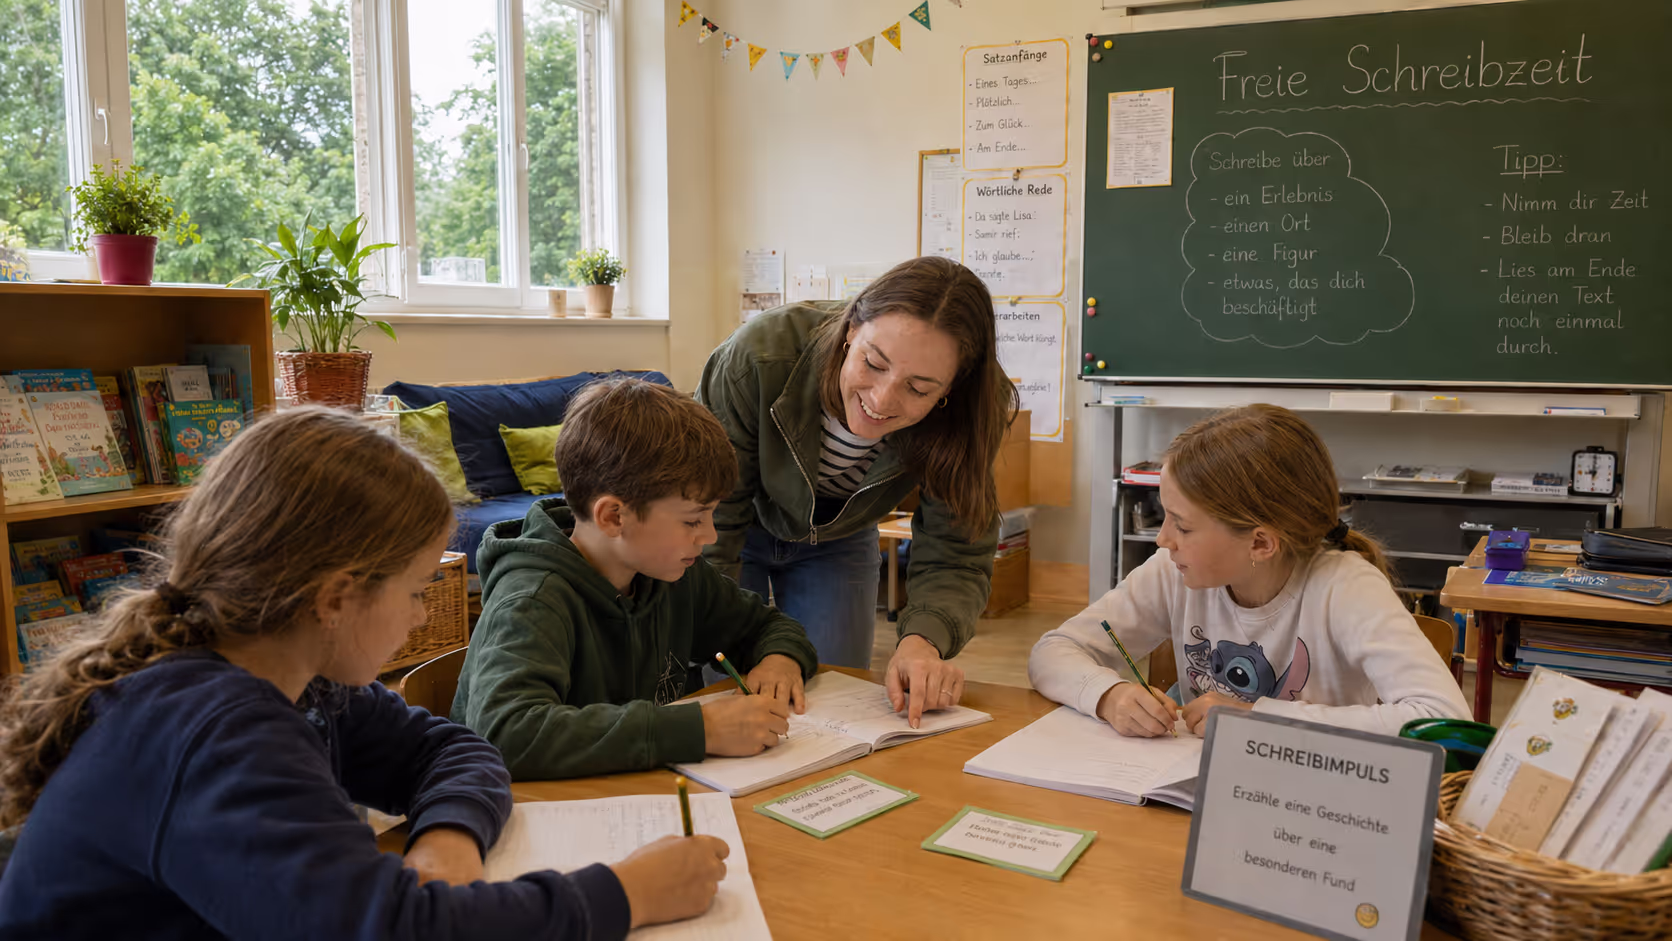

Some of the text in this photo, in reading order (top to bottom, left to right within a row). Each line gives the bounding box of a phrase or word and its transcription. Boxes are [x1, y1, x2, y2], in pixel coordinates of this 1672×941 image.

[983, 50, 1048, 63] Satzanfänge
[1212, 33, 1593, 101] Freie Schreibzeit
[976, 78, 998, 89] Eines
[976, 120, 994, 130] Zum
[976, 142, 991, 152] Am
[1208, 148, 1331, 170] Schreibe über
[1492, 144, 1563, 179] Tipp:
[976, 184, 1052, 196] Wörtliche Rede
[1224, 184, 1334, 206] ein Erlebnis
[1502, 188, 1648, 211] Nimm dir Zeit
[975, 212, 986, 221] Da
[989, 210, 1010, 224] sagte
[1224, 212, 1312, 233] einen Ort
[975, 229, 997, 239] Samir
[1501, 224, 1611, 244] Bleib dran
[975, 250, 988, 260] Ich
[1222, 242, 1318, 268] eine Figur
[1498, 258, 1636, 278] Lies am Ende
[1223, 271, 1365, 292] etwas, das dich
[1499, 286, 1614, 304] deinen Text
[1222, 296, 1318, 322] beschäftigt
[1498, 306, 1624, 328] noch einmal
[1017, 334, 1034, 342] Wort
[1496, 335, 1558, 354] durch.
[1245, 740, 1390, 784] SCHREIBIMPULS
[1233, 786, 1390, 834] Erzähle eine Geschichte
[1274, 828, 1337, 854] über eine
[1244, 850, 1356, 892] besonderen Fund
